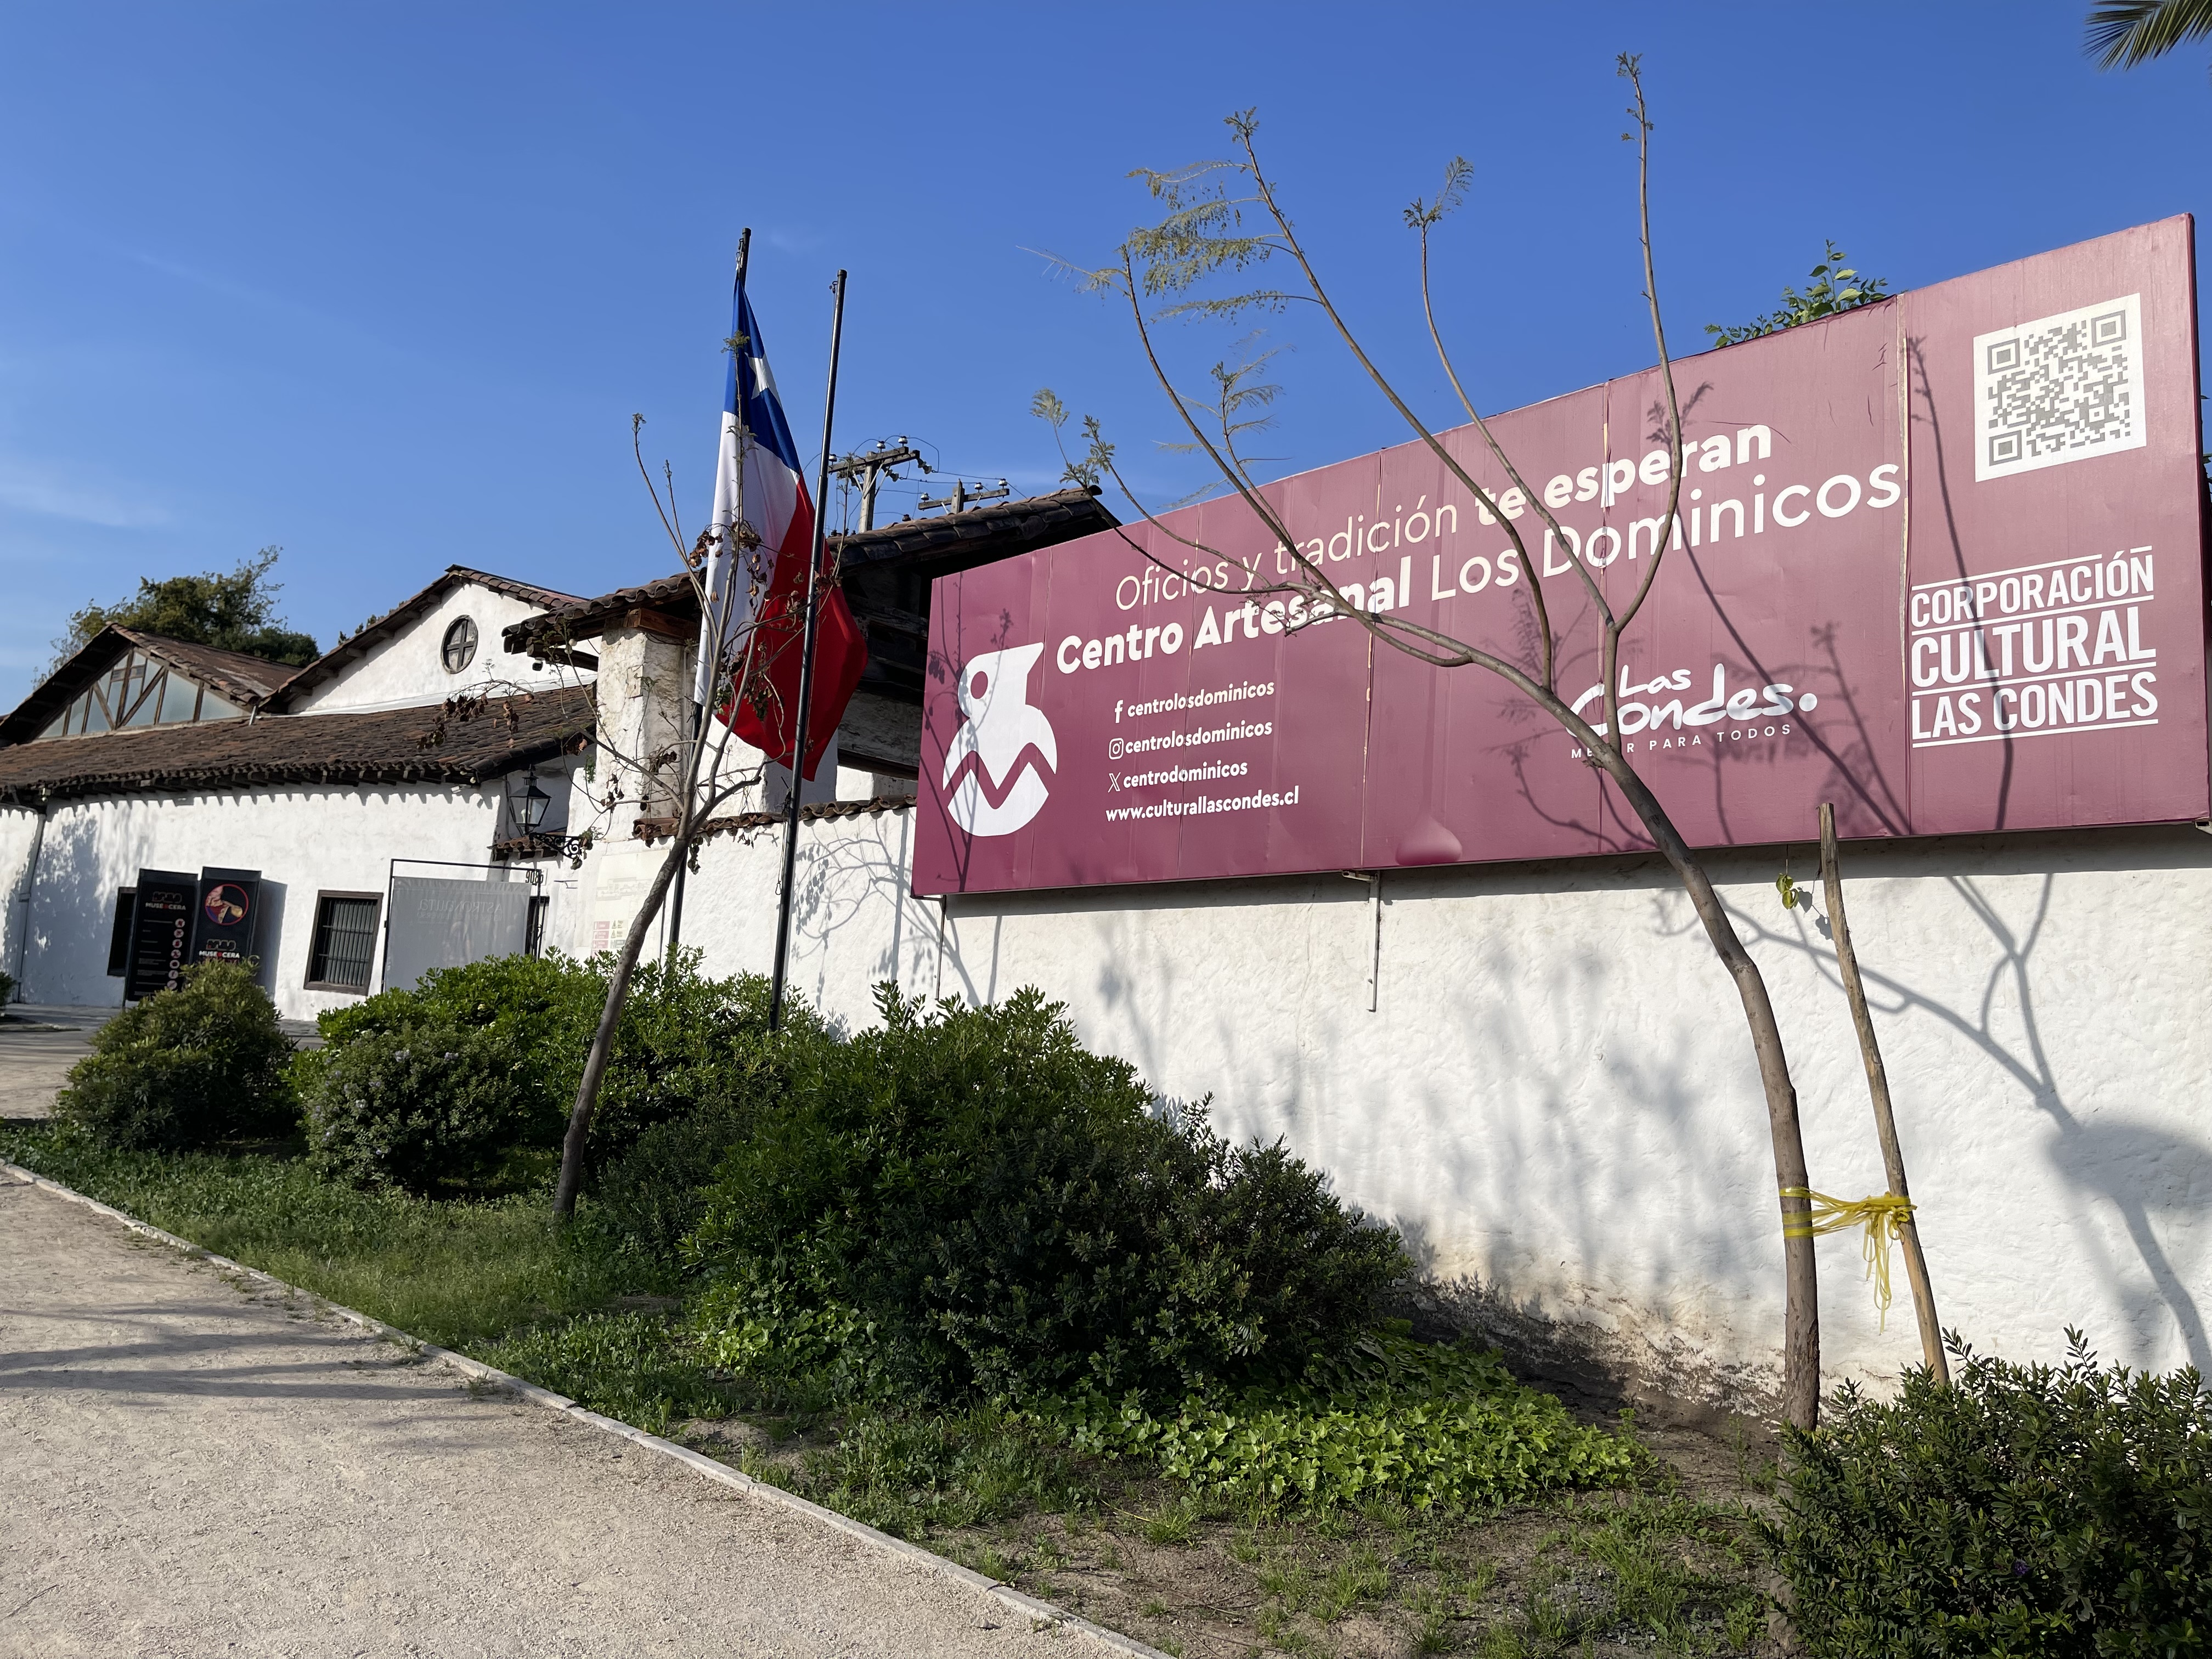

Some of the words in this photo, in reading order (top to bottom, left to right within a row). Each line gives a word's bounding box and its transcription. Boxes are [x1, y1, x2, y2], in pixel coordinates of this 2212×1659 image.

[1116, 559, 1228, 610] Oficios
[1240, 552, 1262, 591] y
[1274, 494, 1457, 574] tradición
[1475, 487, 1527, 526] te
[1543, 424, 1771, 509] esperan
[1057, 622, 1183, 674] Centro
[1193, 555, 1411, 650] Artesanal
[1431, 549, 1519, 601] Los
[1543, 464, 1901, 578] Dominicos
[1911, 551, 2154, 627] CORPORACIÓN
[1911, 606, 2157, 687] CULTURAL
[1127, 681, 1274, 717] centrolosdominicos
[1618, 664, 1691, 698] Las
[1912, 693, 1982, 740] LAS
[1994, 672, 2158, 731] CONDES
[1125, 720, 1272, 754] centrolosdominicos
[1571, 742, 1635, 759] MER
[1649, 735, 1701, 751] PARA
[1717, 724, 1790, 742] TODOS
[1123, 760, 1248, 788] centrodominicos
[1105, 785, 1299, 822] www.culturallascondes.cl
